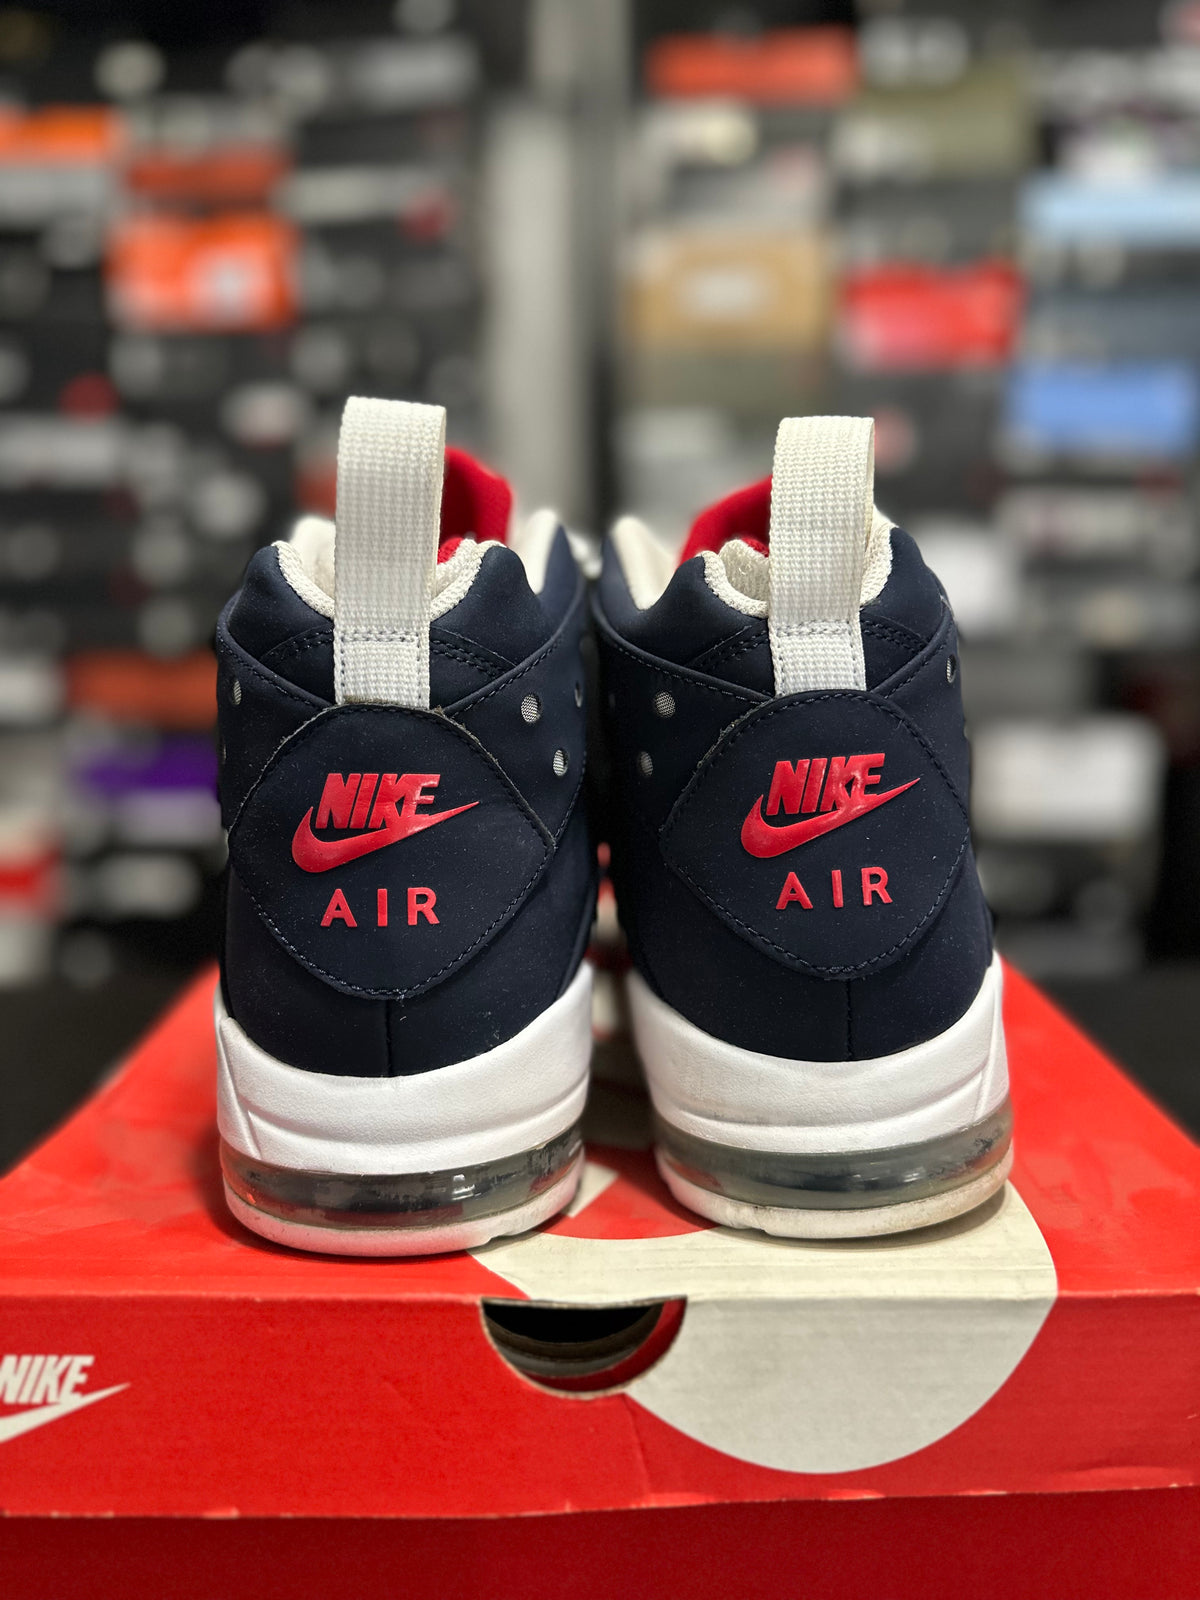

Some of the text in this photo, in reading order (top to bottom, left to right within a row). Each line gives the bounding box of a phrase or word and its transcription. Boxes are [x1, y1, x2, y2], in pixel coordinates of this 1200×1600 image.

[316, 773, 441, 829] NIKE
[766, 753, 886, 815] NIKE
[321, 887, 441, 928] AIR
[776, 866, 893, 910] AIR
[0, 1354, 95, 1405] NIKE
